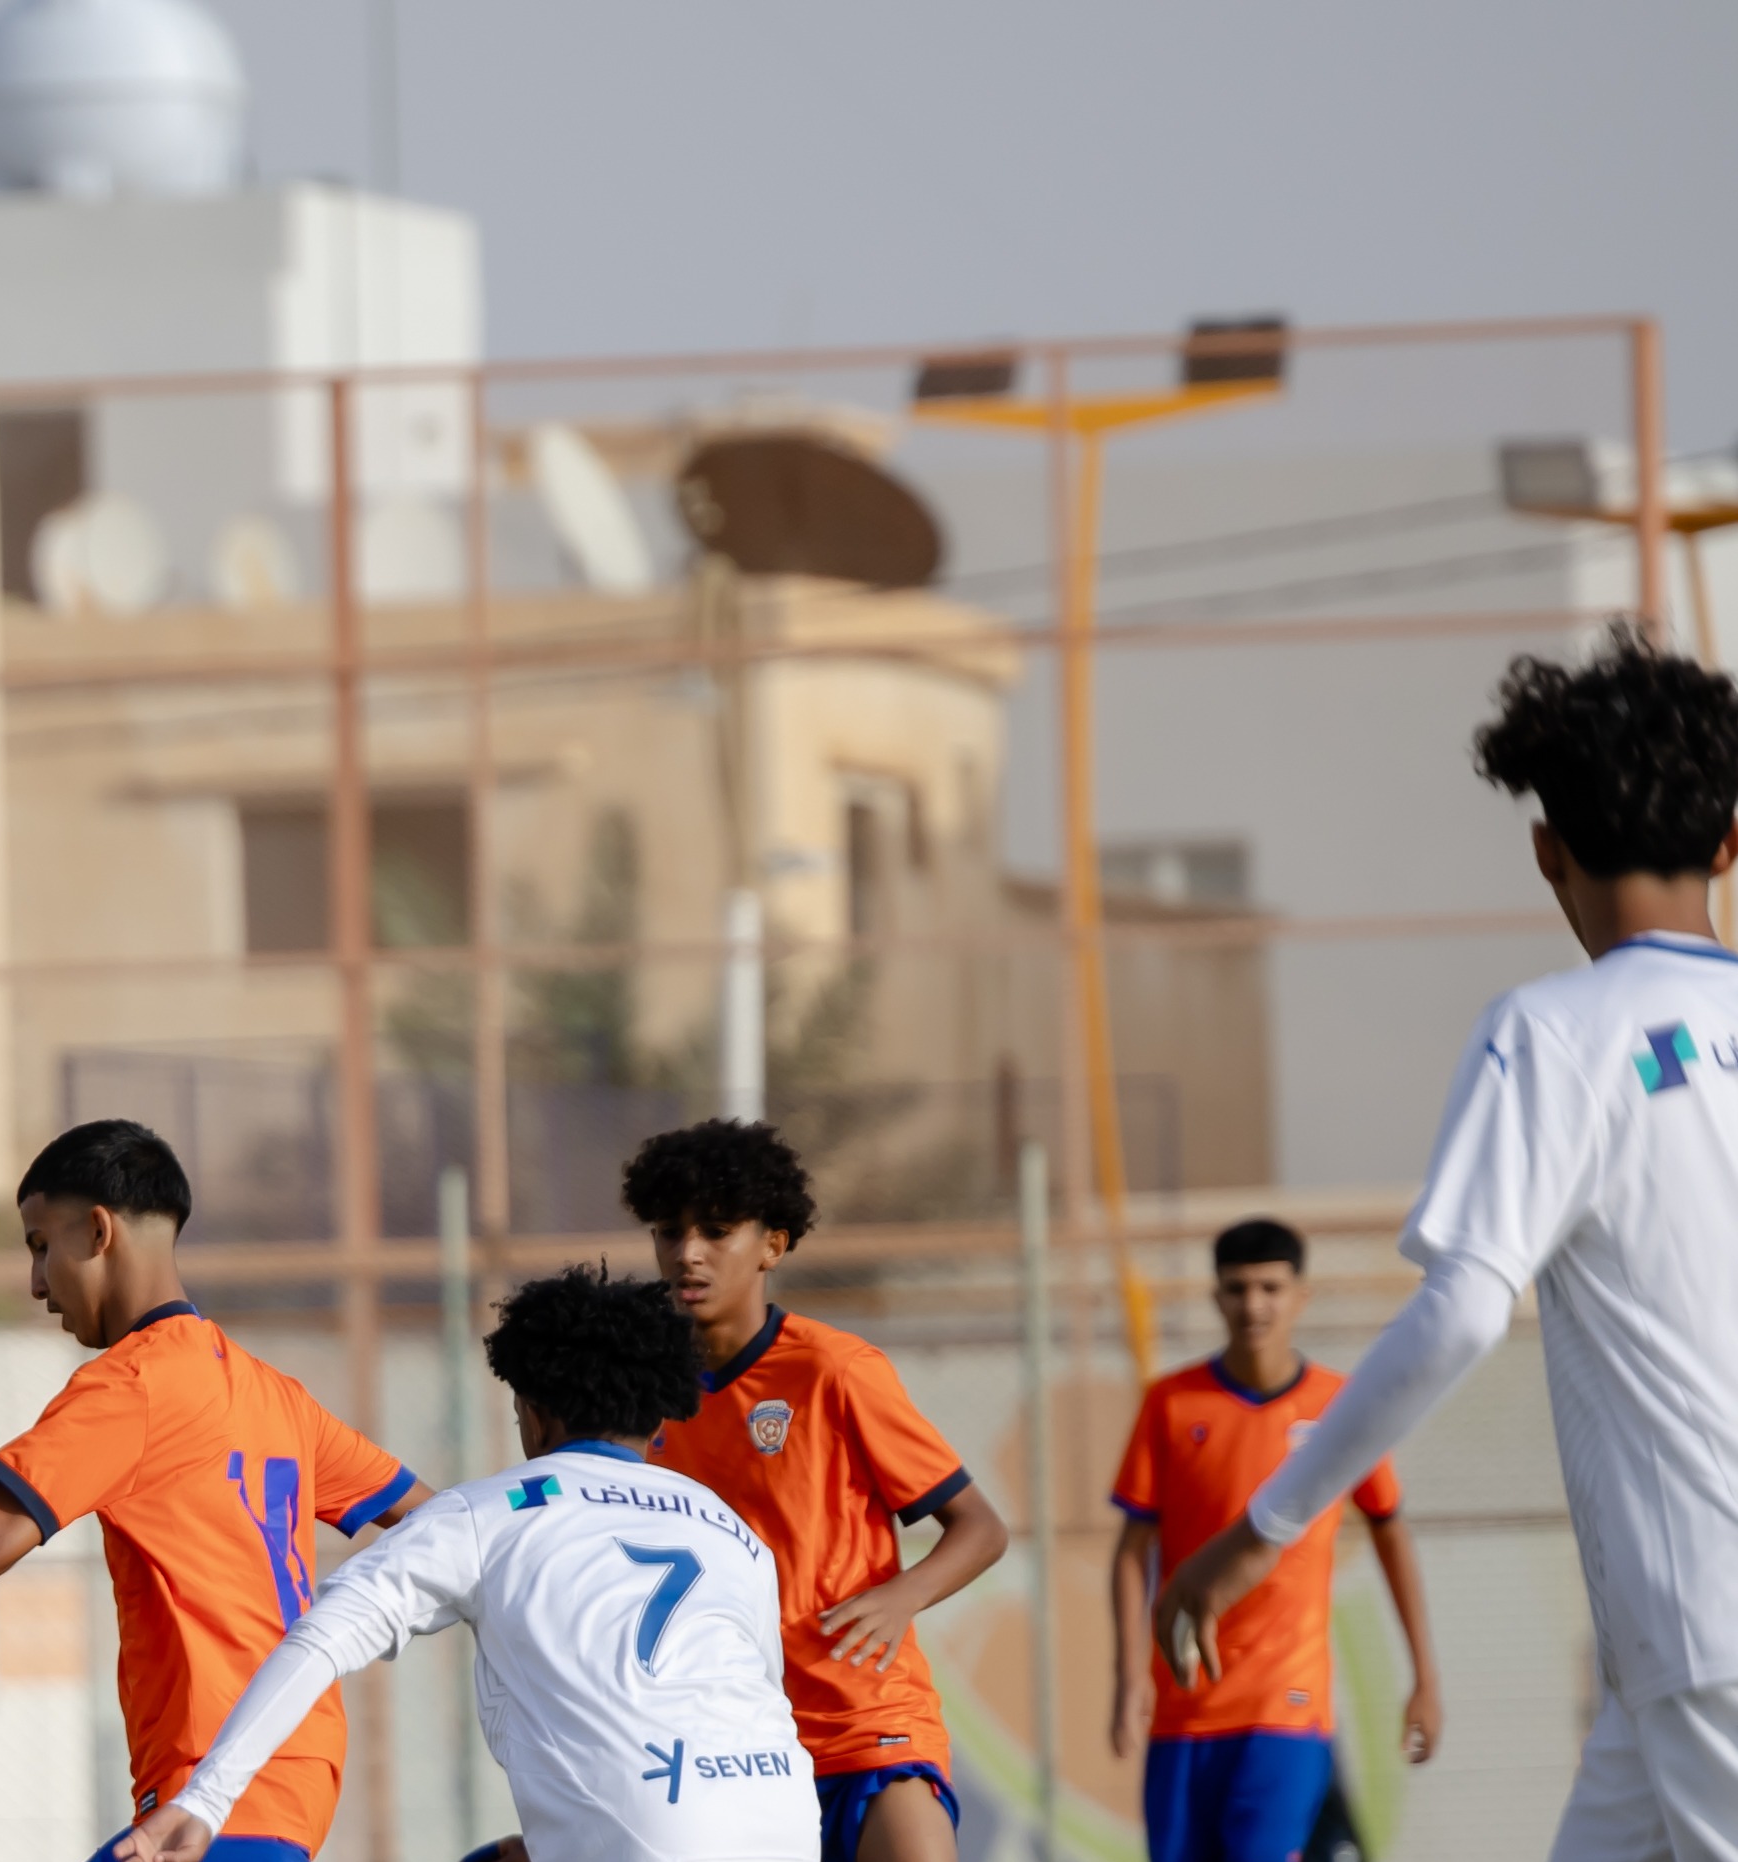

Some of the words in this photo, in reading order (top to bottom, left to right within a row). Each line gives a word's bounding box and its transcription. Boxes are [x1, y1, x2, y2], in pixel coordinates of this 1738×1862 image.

[579, 1484, 693, 1517] الرياض
[612, 1535, 706, 1678] 7
[694, 1751, 792, 1779] SEVEN
